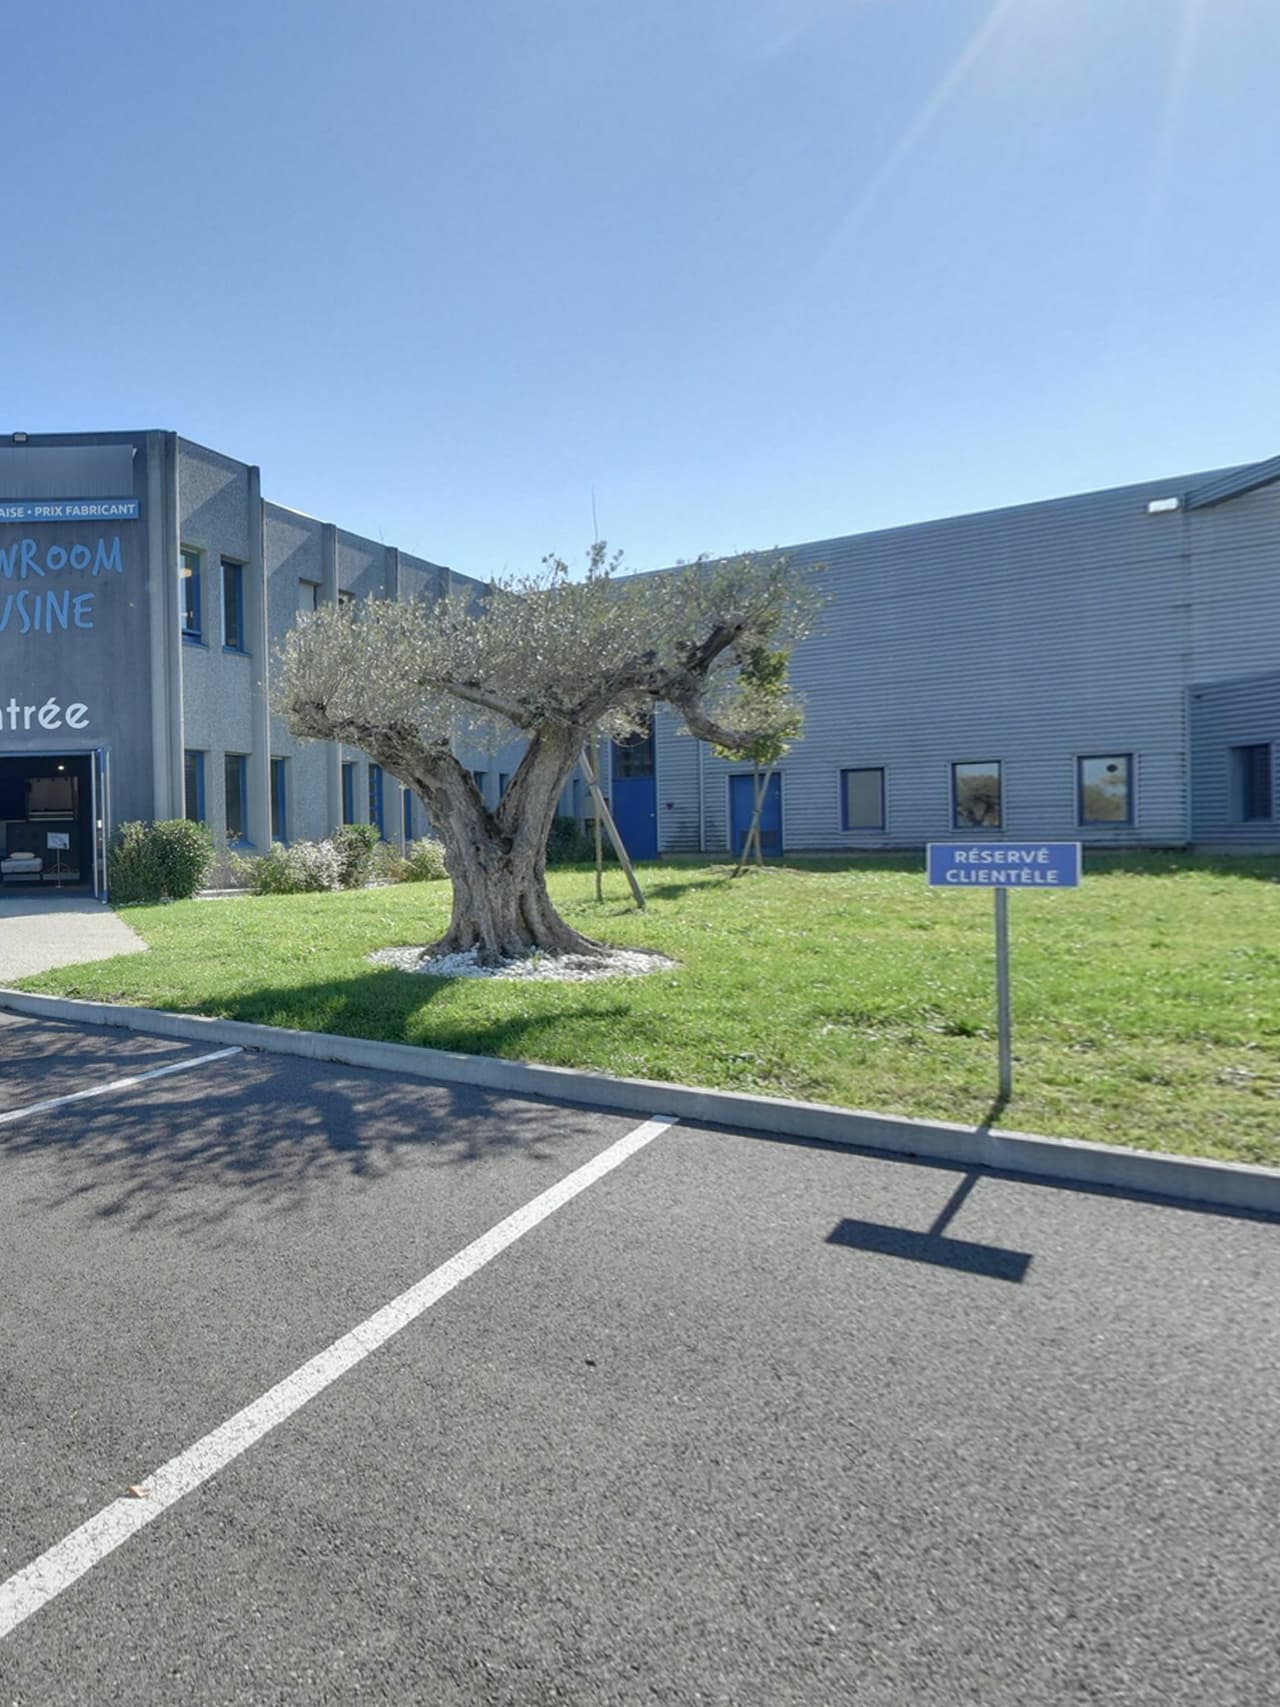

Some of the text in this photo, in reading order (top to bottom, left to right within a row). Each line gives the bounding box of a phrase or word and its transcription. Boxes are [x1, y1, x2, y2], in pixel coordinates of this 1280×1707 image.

[34, 506, 62, 517] PRIX
[65, 504, 135, 516] FABRICANT
[954, 848, 1049, 864] RÉSERVÉ
[945, 867, 1059, 883] CLIENTÈLE
